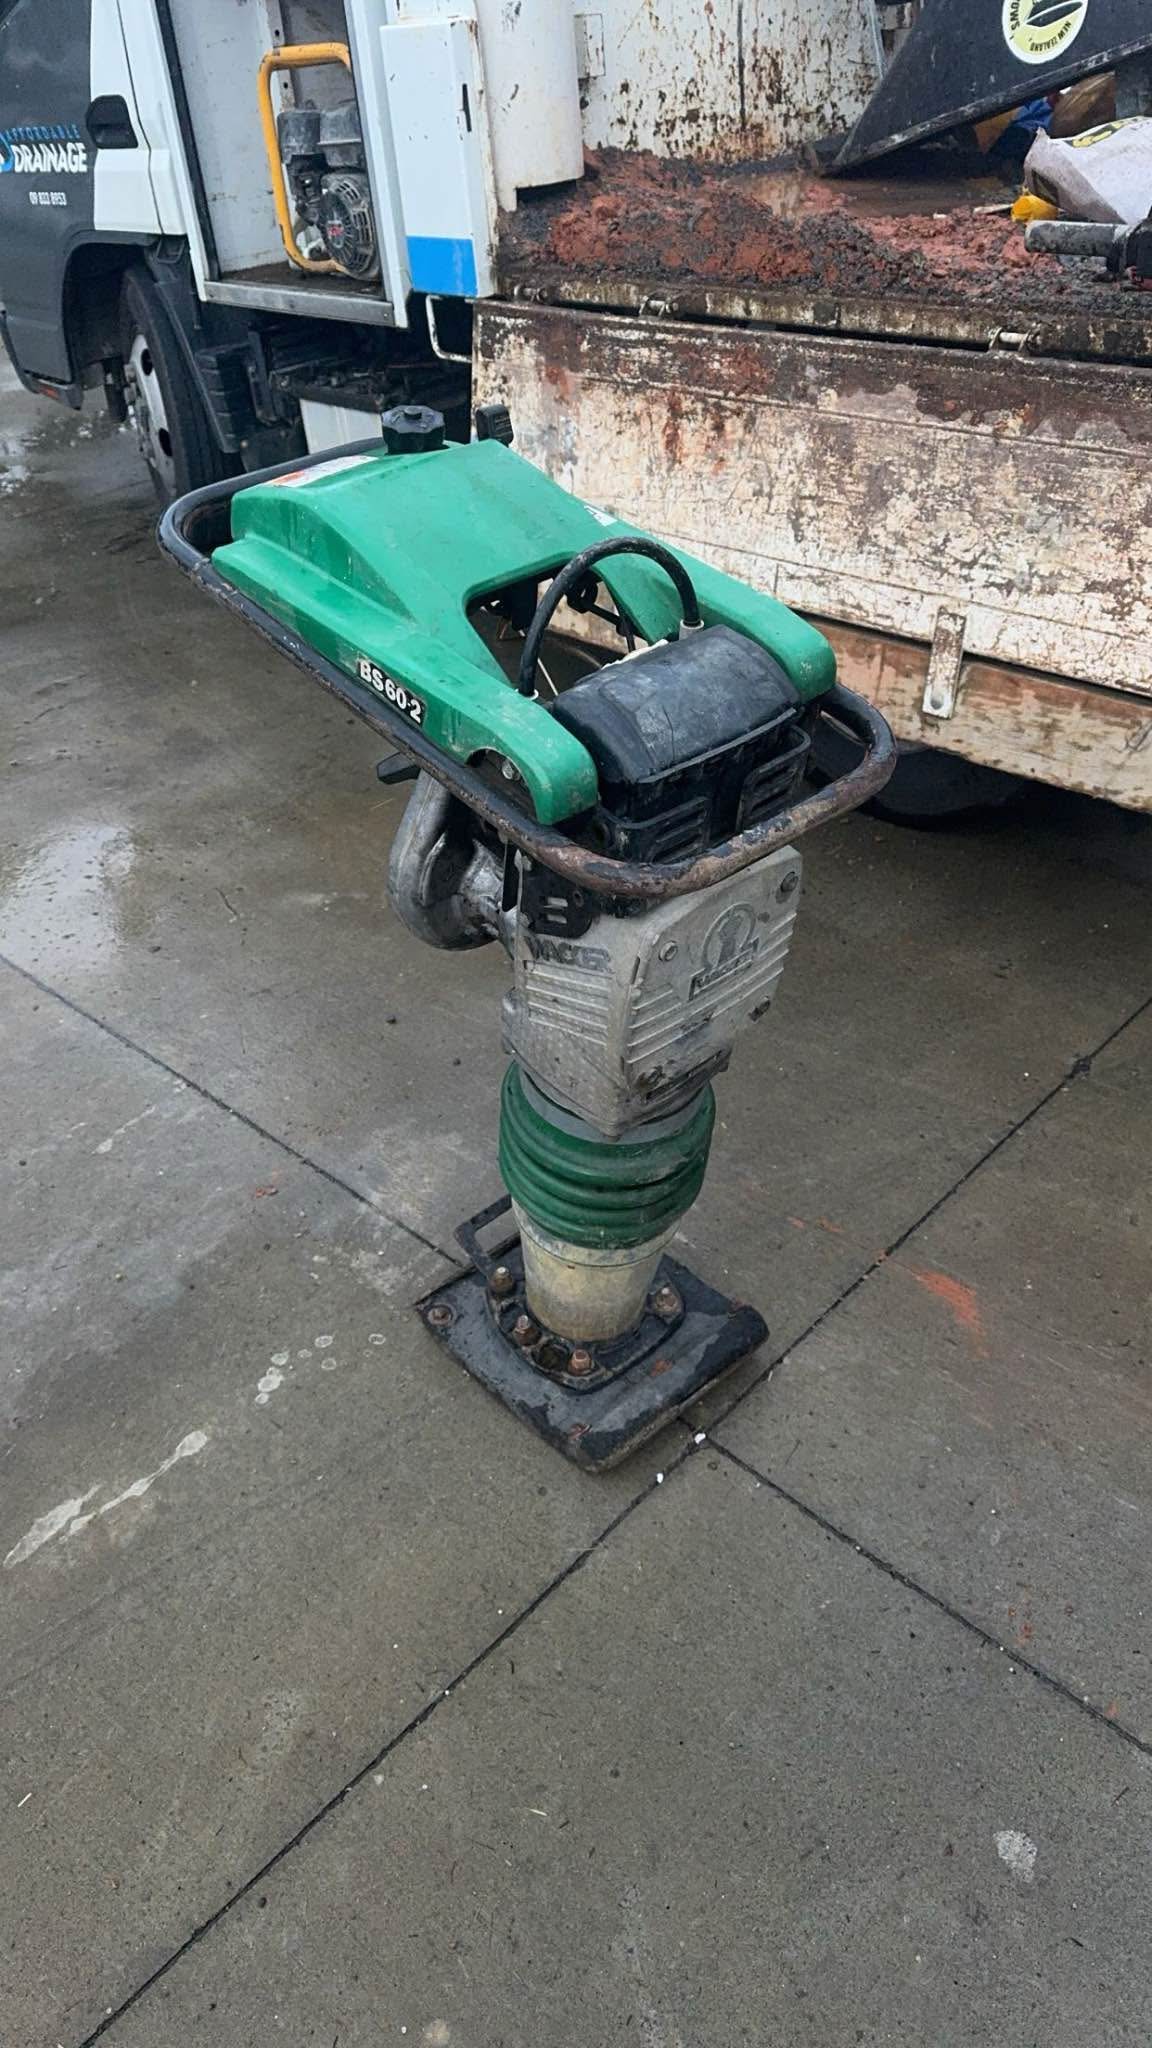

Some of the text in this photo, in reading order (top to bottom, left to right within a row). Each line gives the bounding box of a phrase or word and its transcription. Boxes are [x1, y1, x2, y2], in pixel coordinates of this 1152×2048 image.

[1009, 0, 1021, 31] OWS
[1029, 21, 1072, 52] NEW ZEALAND
[10, 142, 88, 173] DRAINAGE
